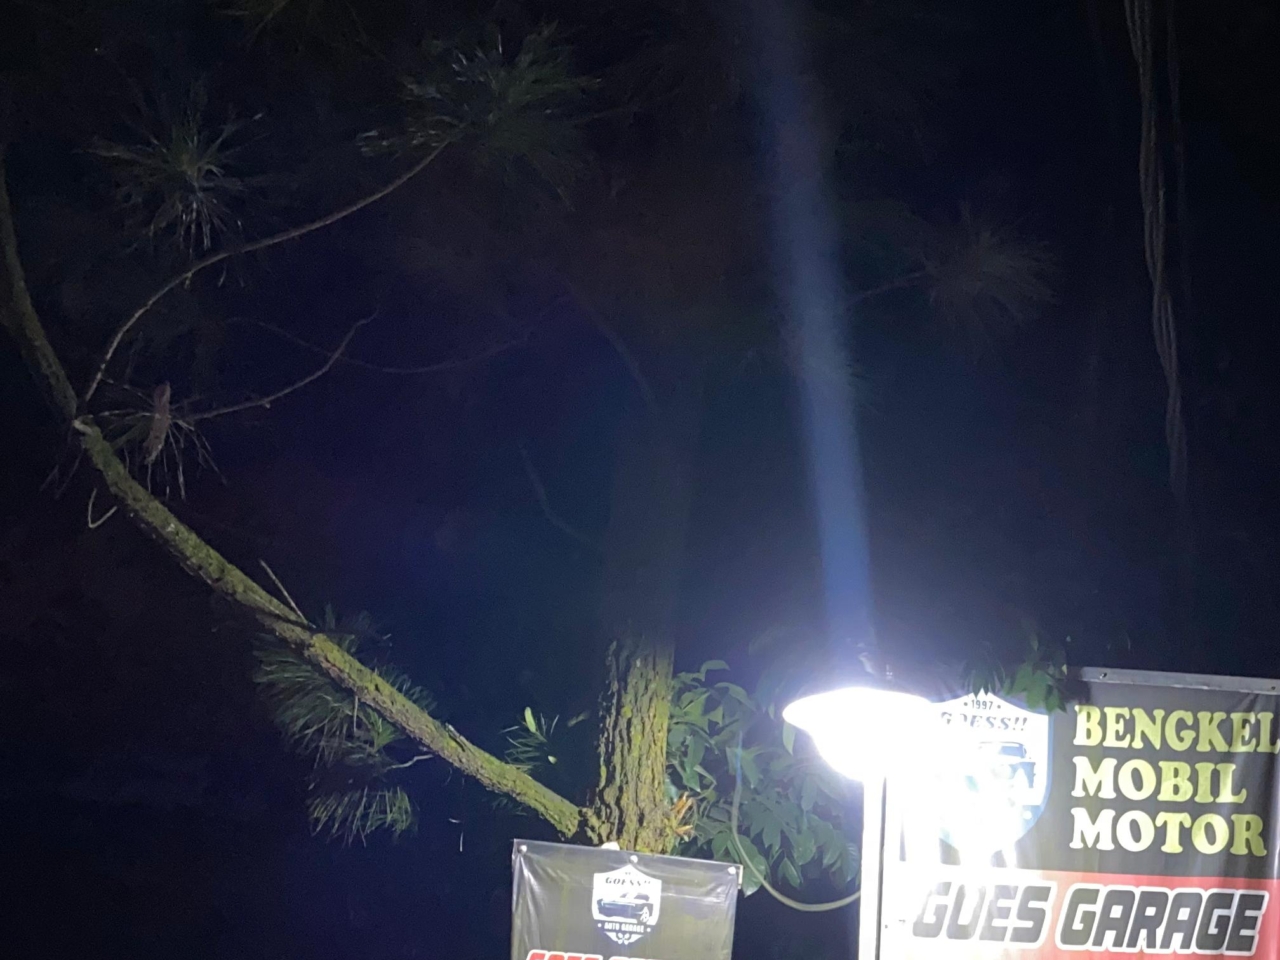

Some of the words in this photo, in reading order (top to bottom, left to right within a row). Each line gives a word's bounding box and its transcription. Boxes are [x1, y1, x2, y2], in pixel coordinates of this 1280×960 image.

[971, 699, 994, 710] 1997
[1073, 705, 1280, 754] BENGKEL
[1071, 756, 1247, 803] MOBIL
[1069, 807, 1267, 857] MOTOR
[604, 922, 620, 931] AUTO
[621, 923, 644, 933] GARAGE
[910, 880, 1053, 946] GOES
[1057, 884, 1268, 955] GARAGE
